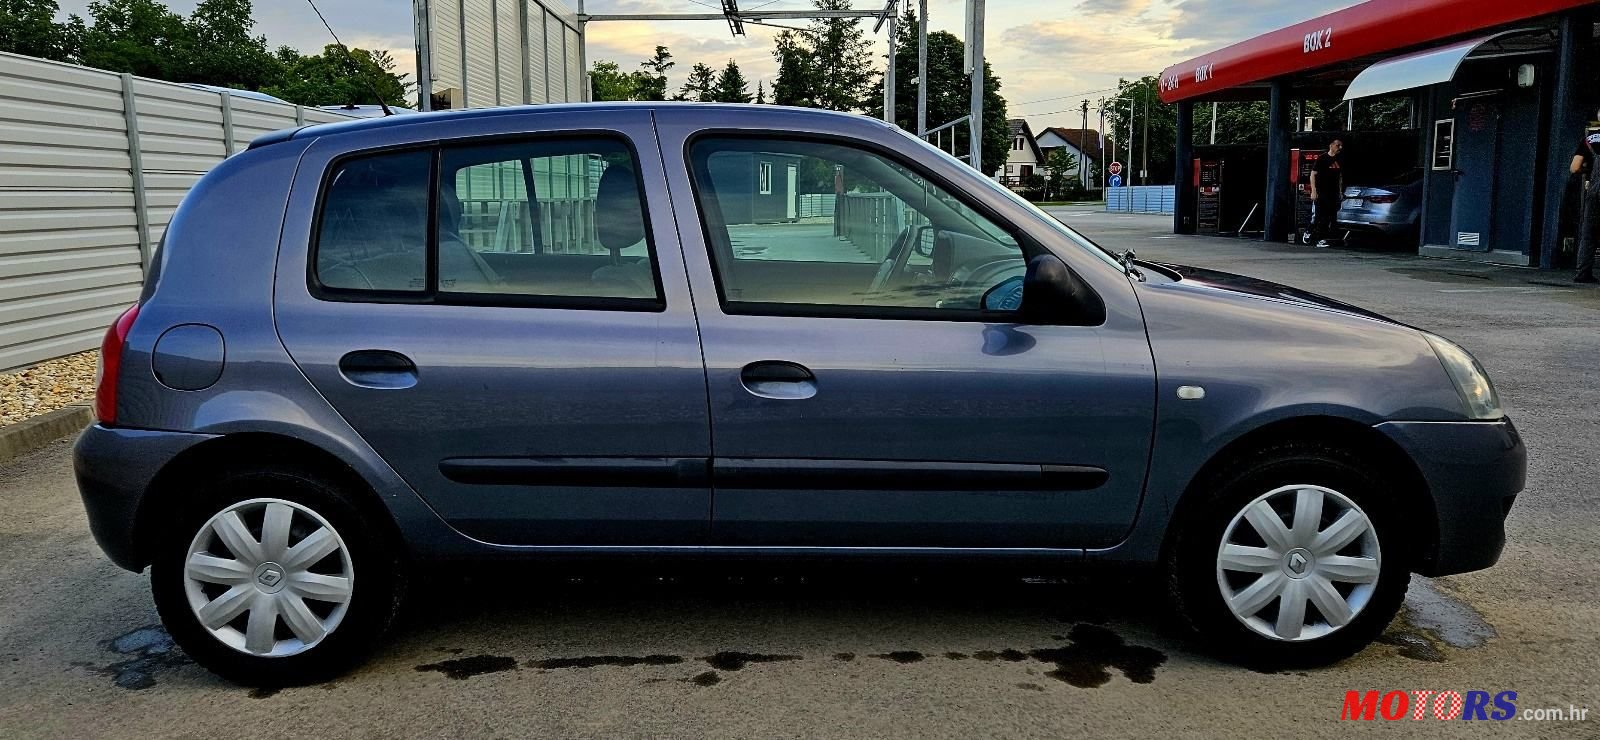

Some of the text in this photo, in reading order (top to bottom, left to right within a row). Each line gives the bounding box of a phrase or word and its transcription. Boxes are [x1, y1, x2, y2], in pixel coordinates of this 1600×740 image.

[1303, 27, 1332, 53] BOX 2
[1195, 62, 1214, 83] BOX 1
